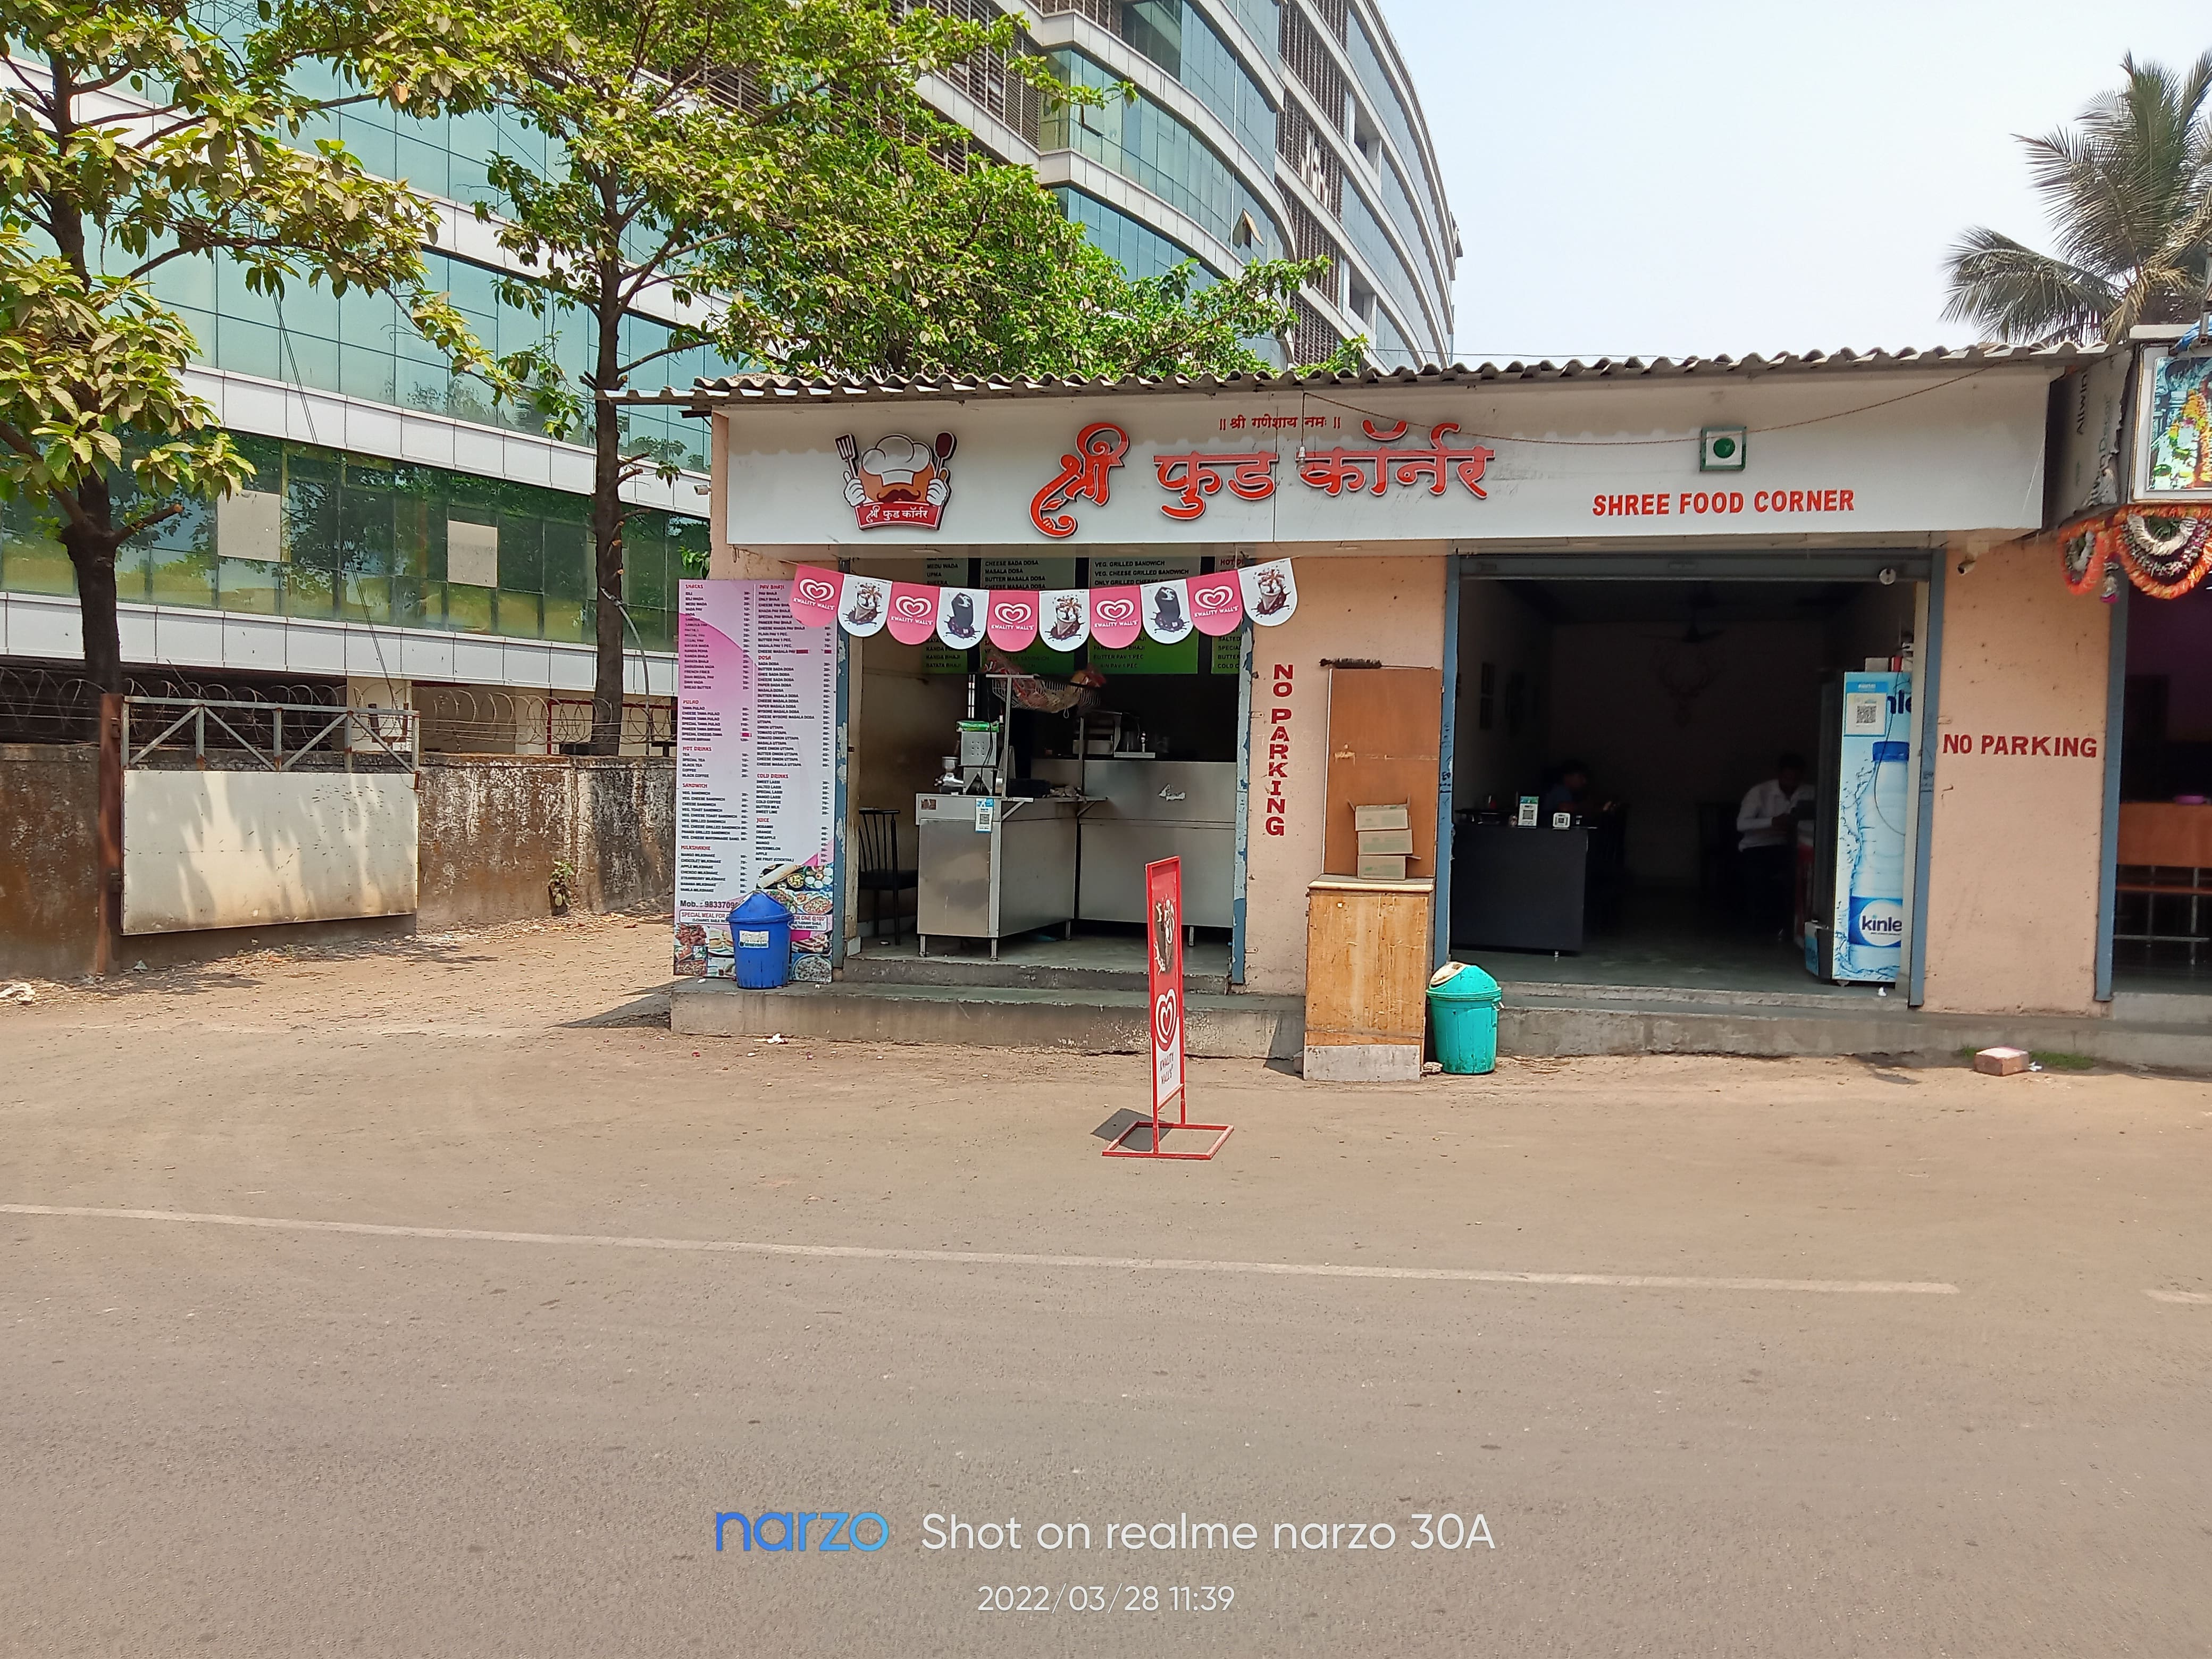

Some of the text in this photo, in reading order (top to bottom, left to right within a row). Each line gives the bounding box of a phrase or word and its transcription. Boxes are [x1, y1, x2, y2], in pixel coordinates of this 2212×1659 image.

[1230, 416, 1246, 429] श्री
[1251, 416, 1298, 429] गणेशाय
[1305, 417, 1327, 429] नमः
[1029, 419, 1495, 538] श्री फुड कॉर्नर
[1593, 489, 1855, 516] SHREE FOOD CORNER
[866, 504, 929, 523] श्री फुड कॉर्नर
[793, 597, 835, 611] KWALITY WALL'S
[1194, 606, 1239, 618] KWALITY WALL'S
[1265, 664, 1294, 836] NO PARKING
[1942, 734, 2097, 758] NO PARKING
[1862, 915, 1902, 932] kinle
